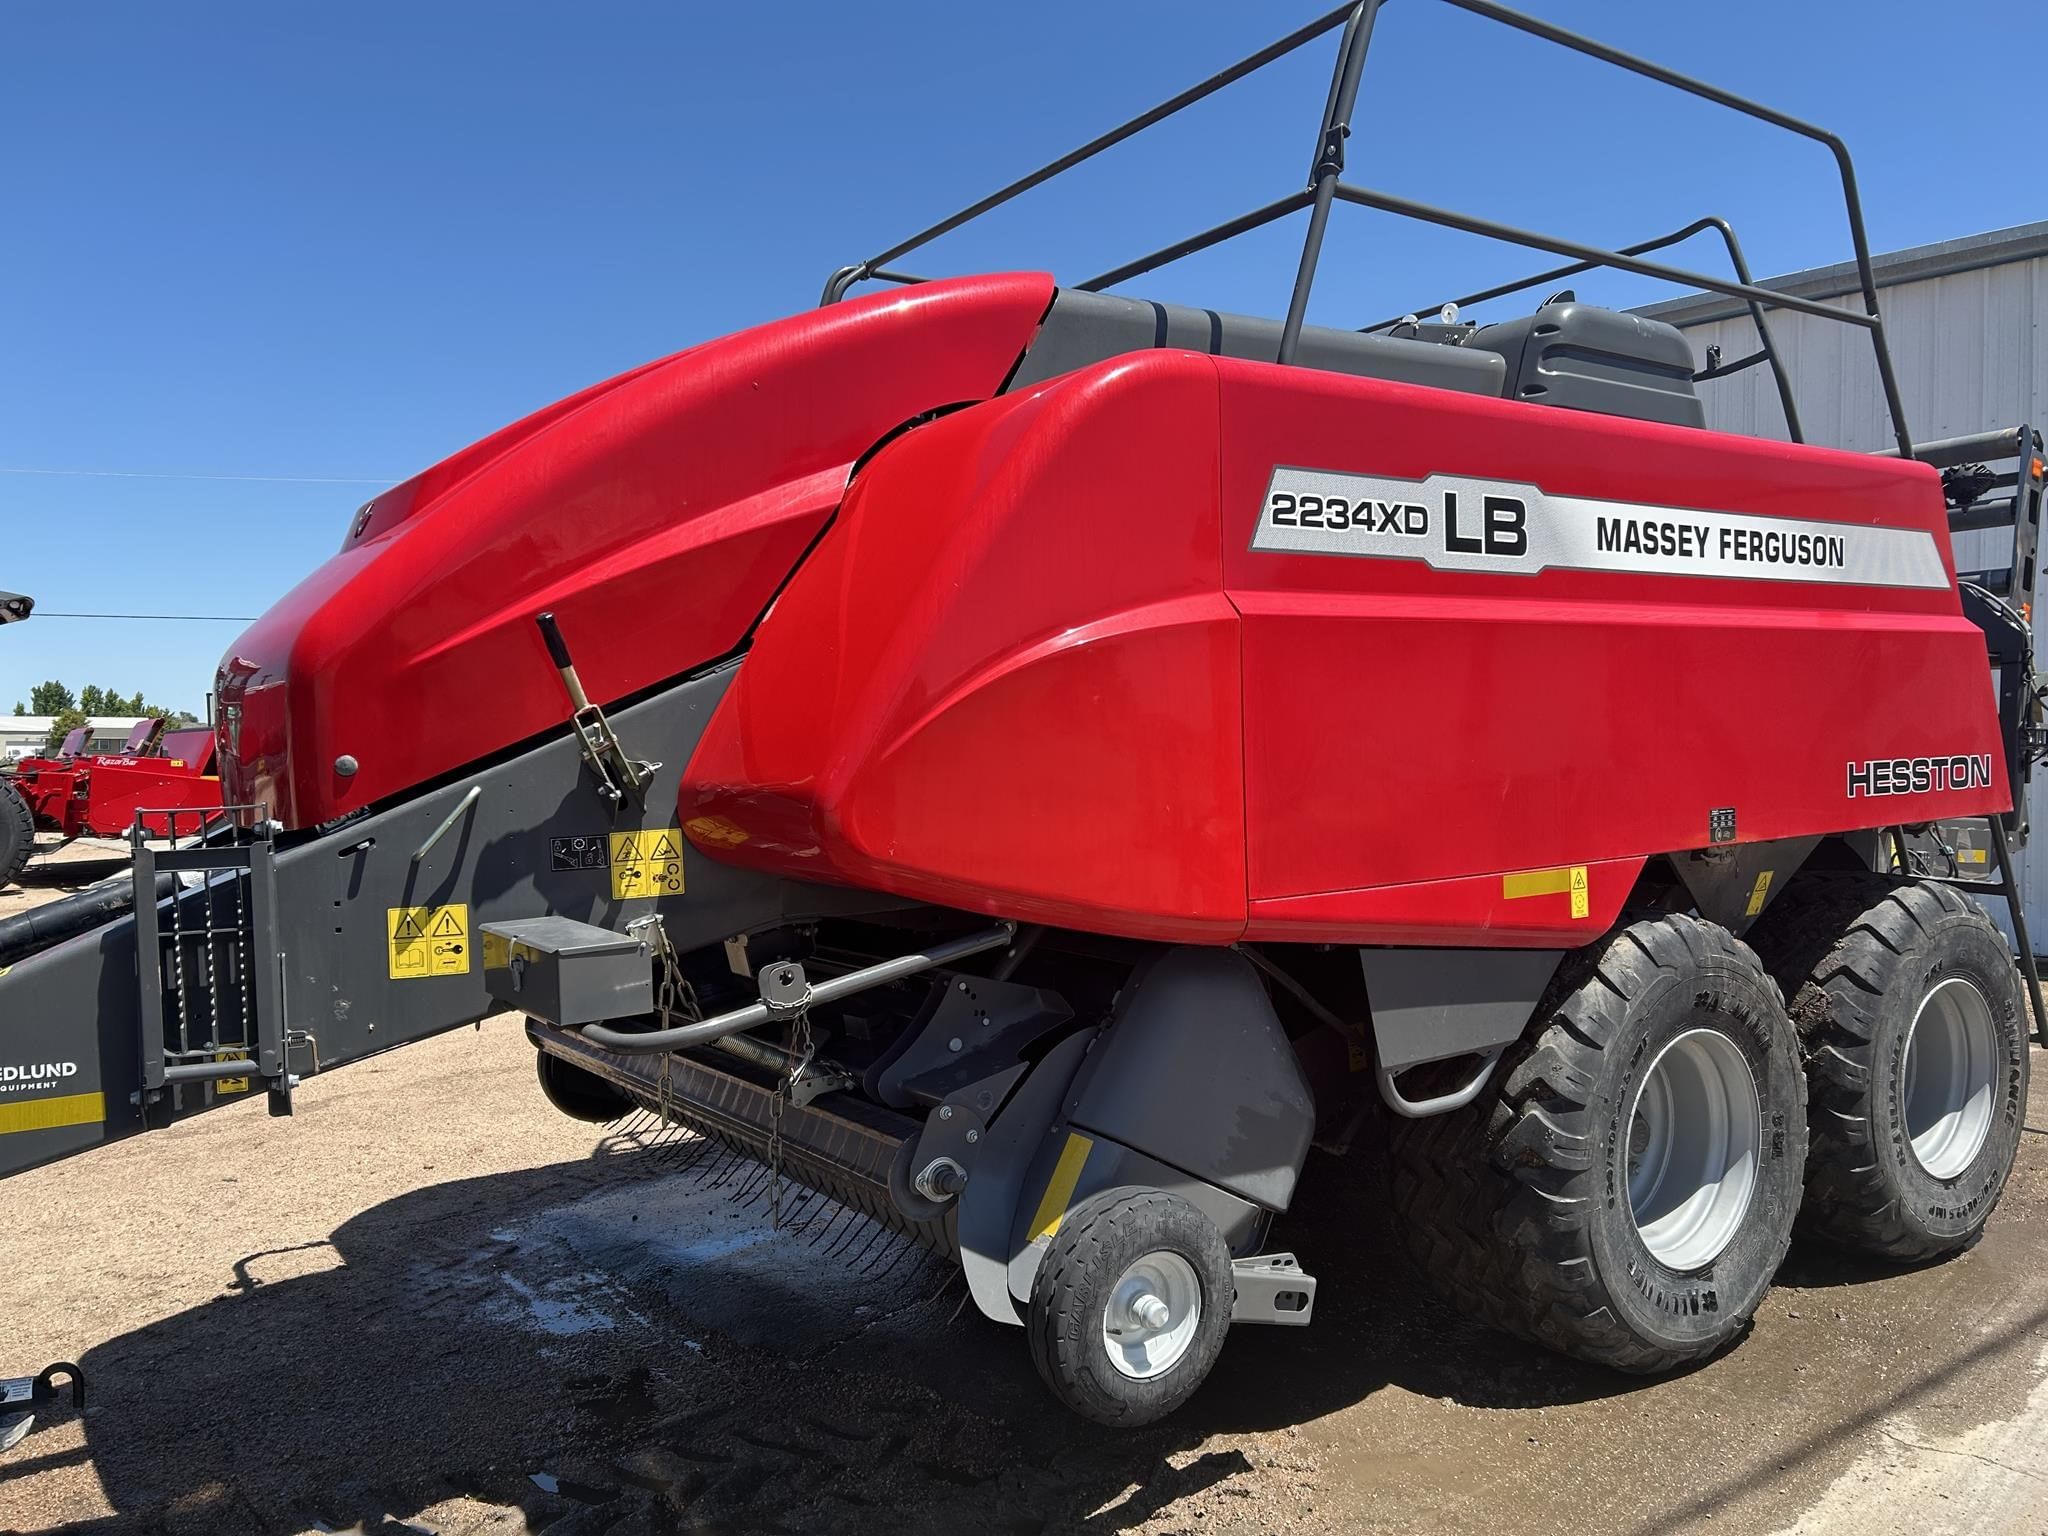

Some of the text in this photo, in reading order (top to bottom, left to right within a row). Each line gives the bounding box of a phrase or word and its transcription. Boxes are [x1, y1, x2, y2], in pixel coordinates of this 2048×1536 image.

[1271, 491, 1528, 557] 2234XD LB
[1597, 516, 1846, 567] MASSEY FERGUSON
[1847, 754, 1992, 799] HESSTON
[0, 1061, 77, 1081] DLUND
